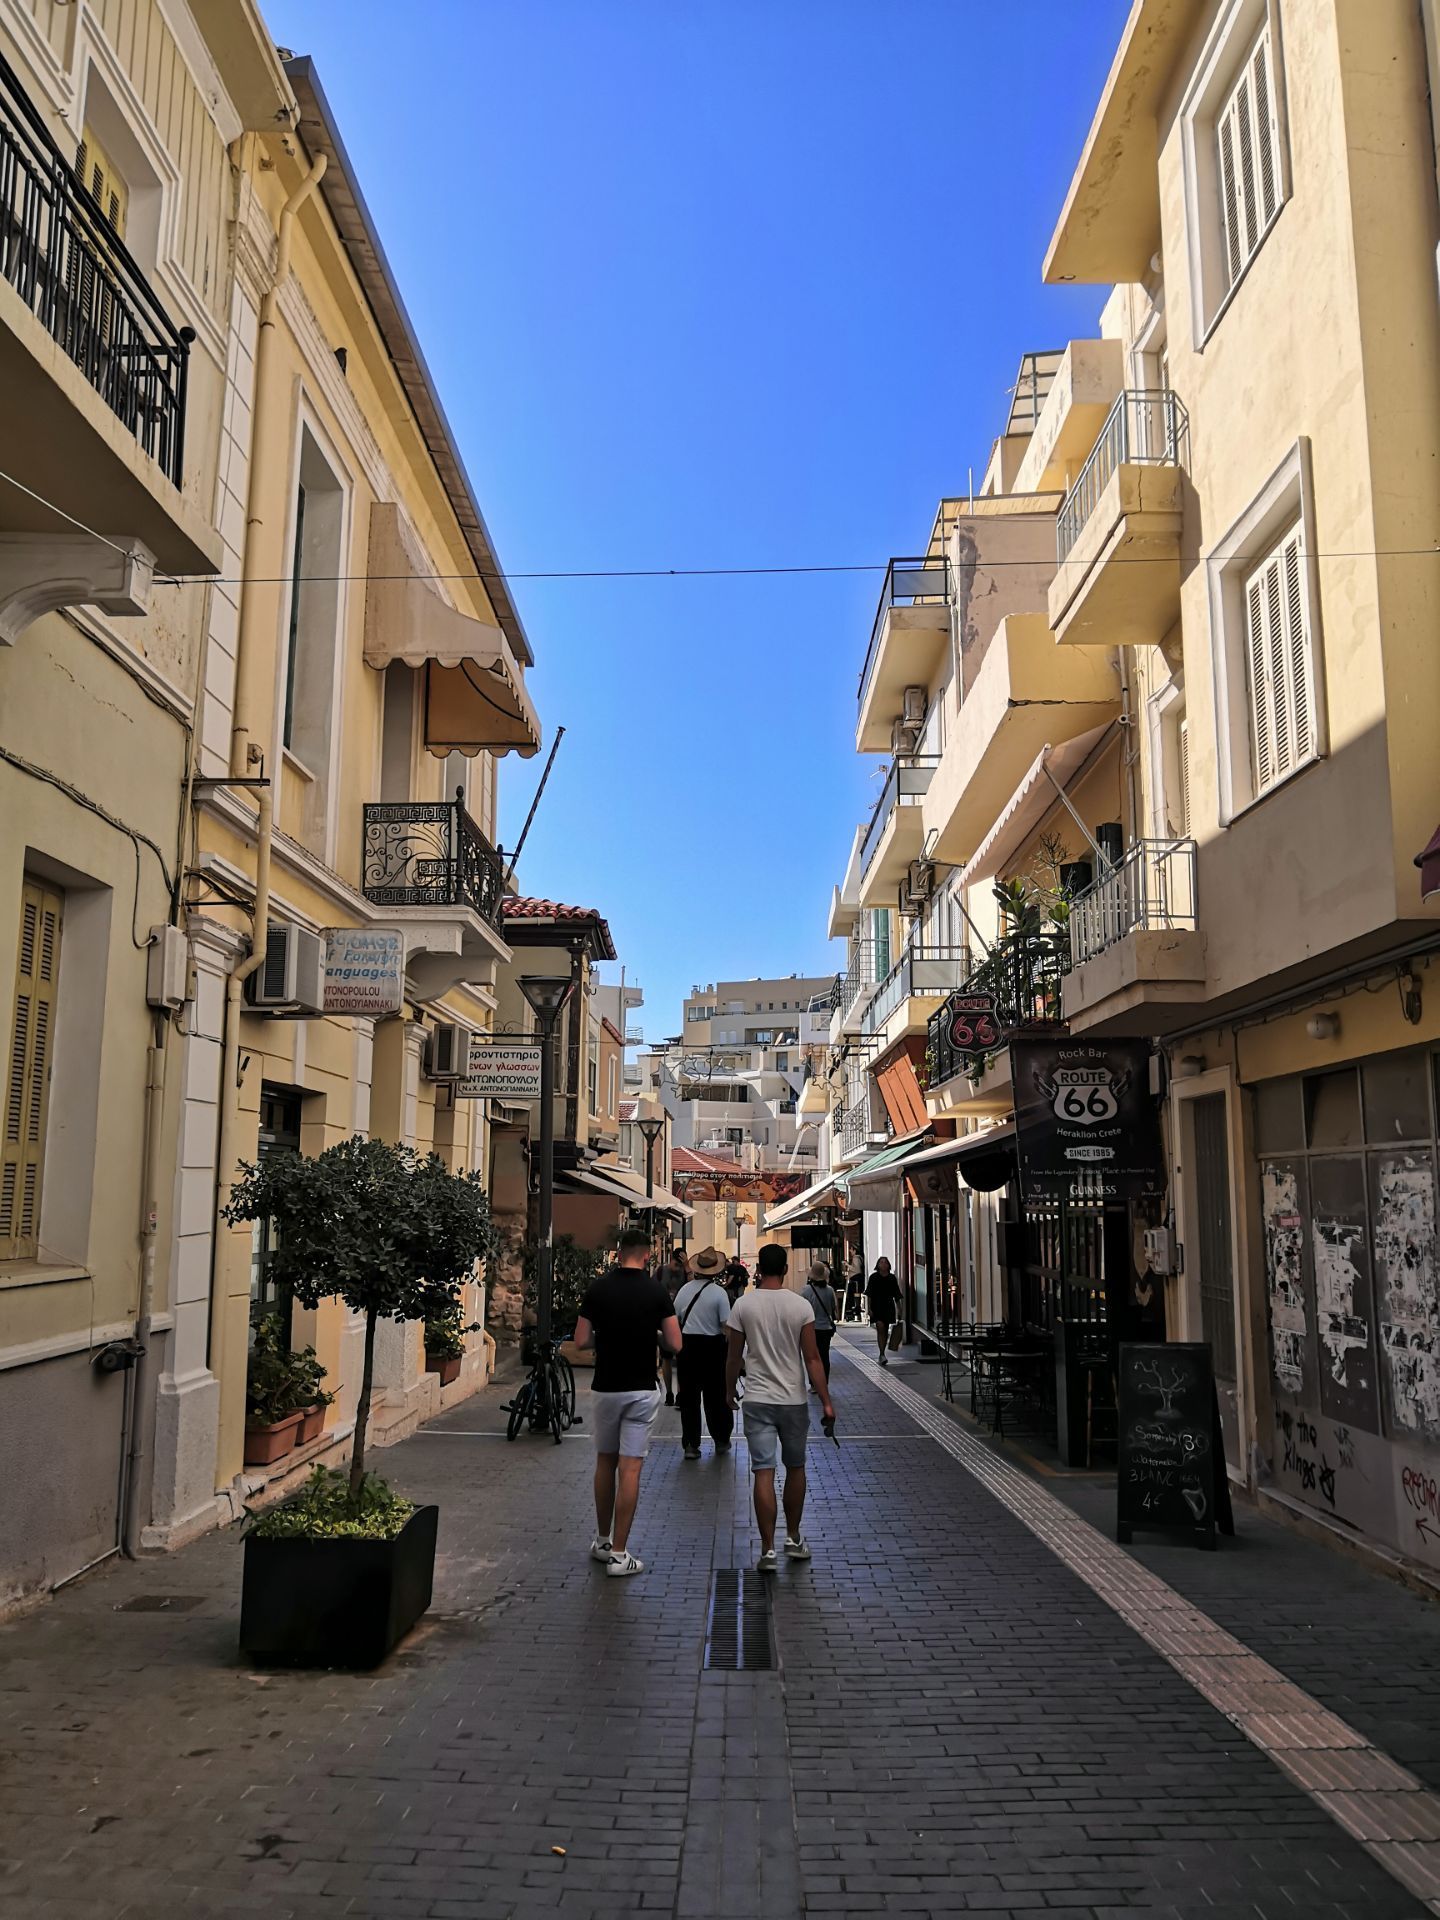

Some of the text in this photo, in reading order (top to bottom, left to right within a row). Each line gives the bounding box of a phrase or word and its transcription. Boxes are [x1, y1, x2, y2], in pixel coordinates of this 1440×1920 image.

[326, 968, 397, 980] anguages
[955, 998, 990, 1009] ROUTE
[953, 1016, 995, 1045] 66
[1059, 1048, 1108, 1060] Rock Bar
[496, 1062, 540, 1072] γλωσσων
[1060, 1072, 1106, 1083] ROUTE
[1064, 1087, 1108, 1117] 66
[1056, 1128, 1122, 1139] Heraklion Crete
[1069, 1149, 1090, 1158] SINCE
[1070, 1185, 1117, 1195] GUINNESS
